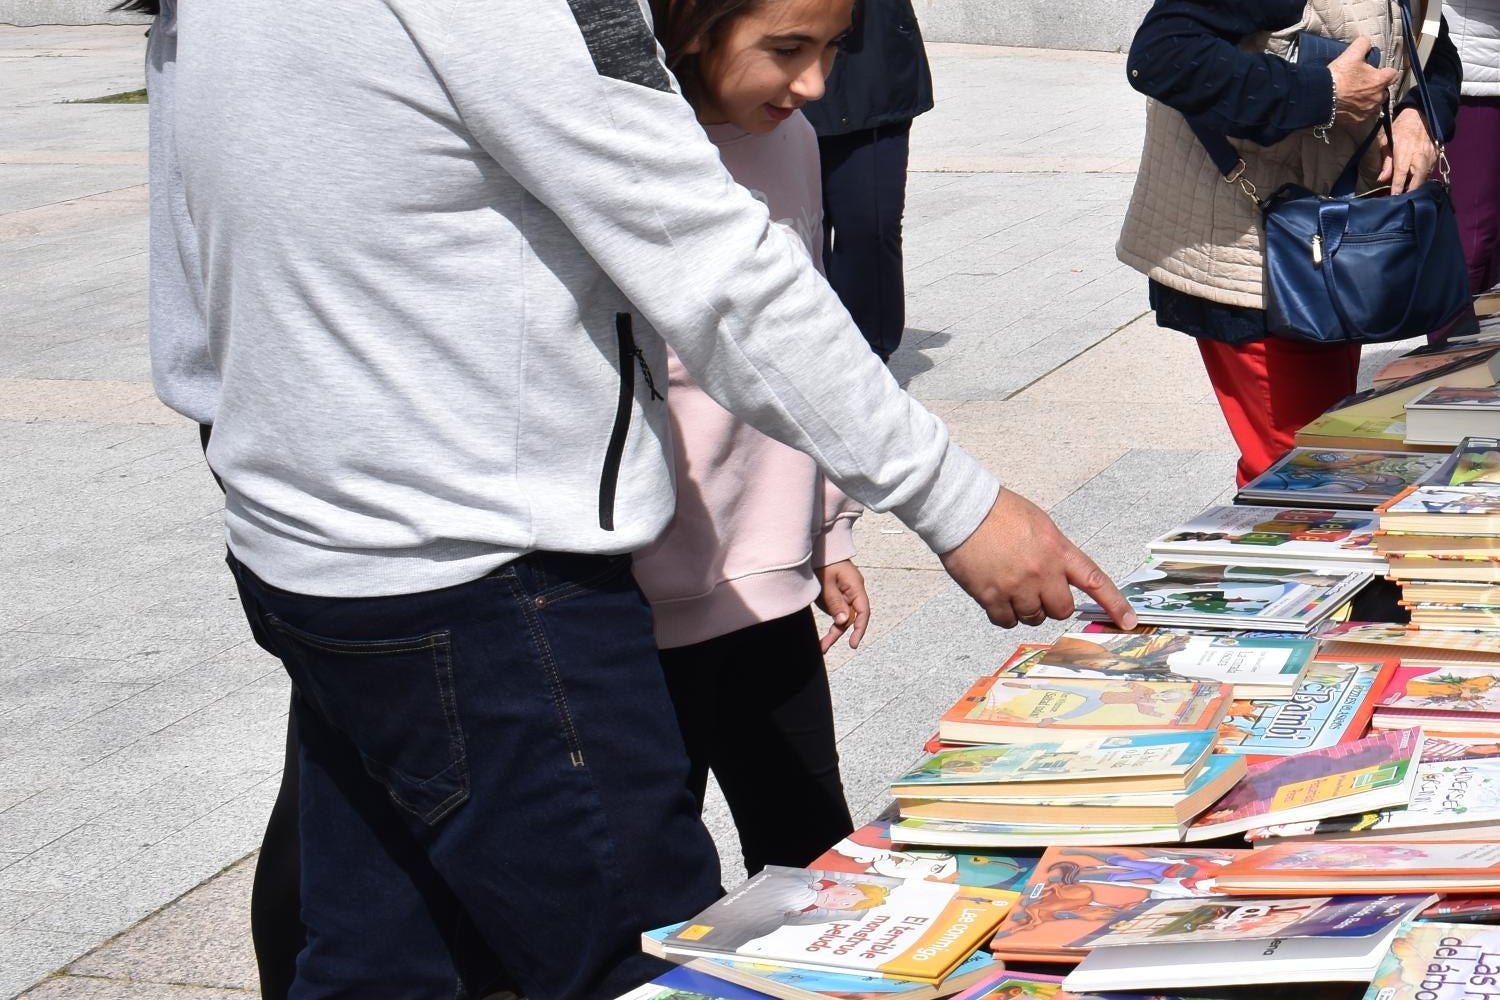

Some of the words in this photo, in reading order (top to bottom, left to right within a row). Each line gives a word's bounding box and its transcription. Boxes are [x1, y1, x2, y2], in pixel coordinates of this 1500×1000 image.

[1261, 684, 1336, 742] Bambi
[900, 914, 930, 926] El
[962, 907, 988, 924] Lee
[805, 923, 852, 954] peludo
[832, 914, 891, 957] monstruo
[858, 925, 916, 960] terrible
[912, 923, 970, 962] conmigo
[1432, 936, 1483, 961] del
[1414, 962, 1468, 1000] árbo
